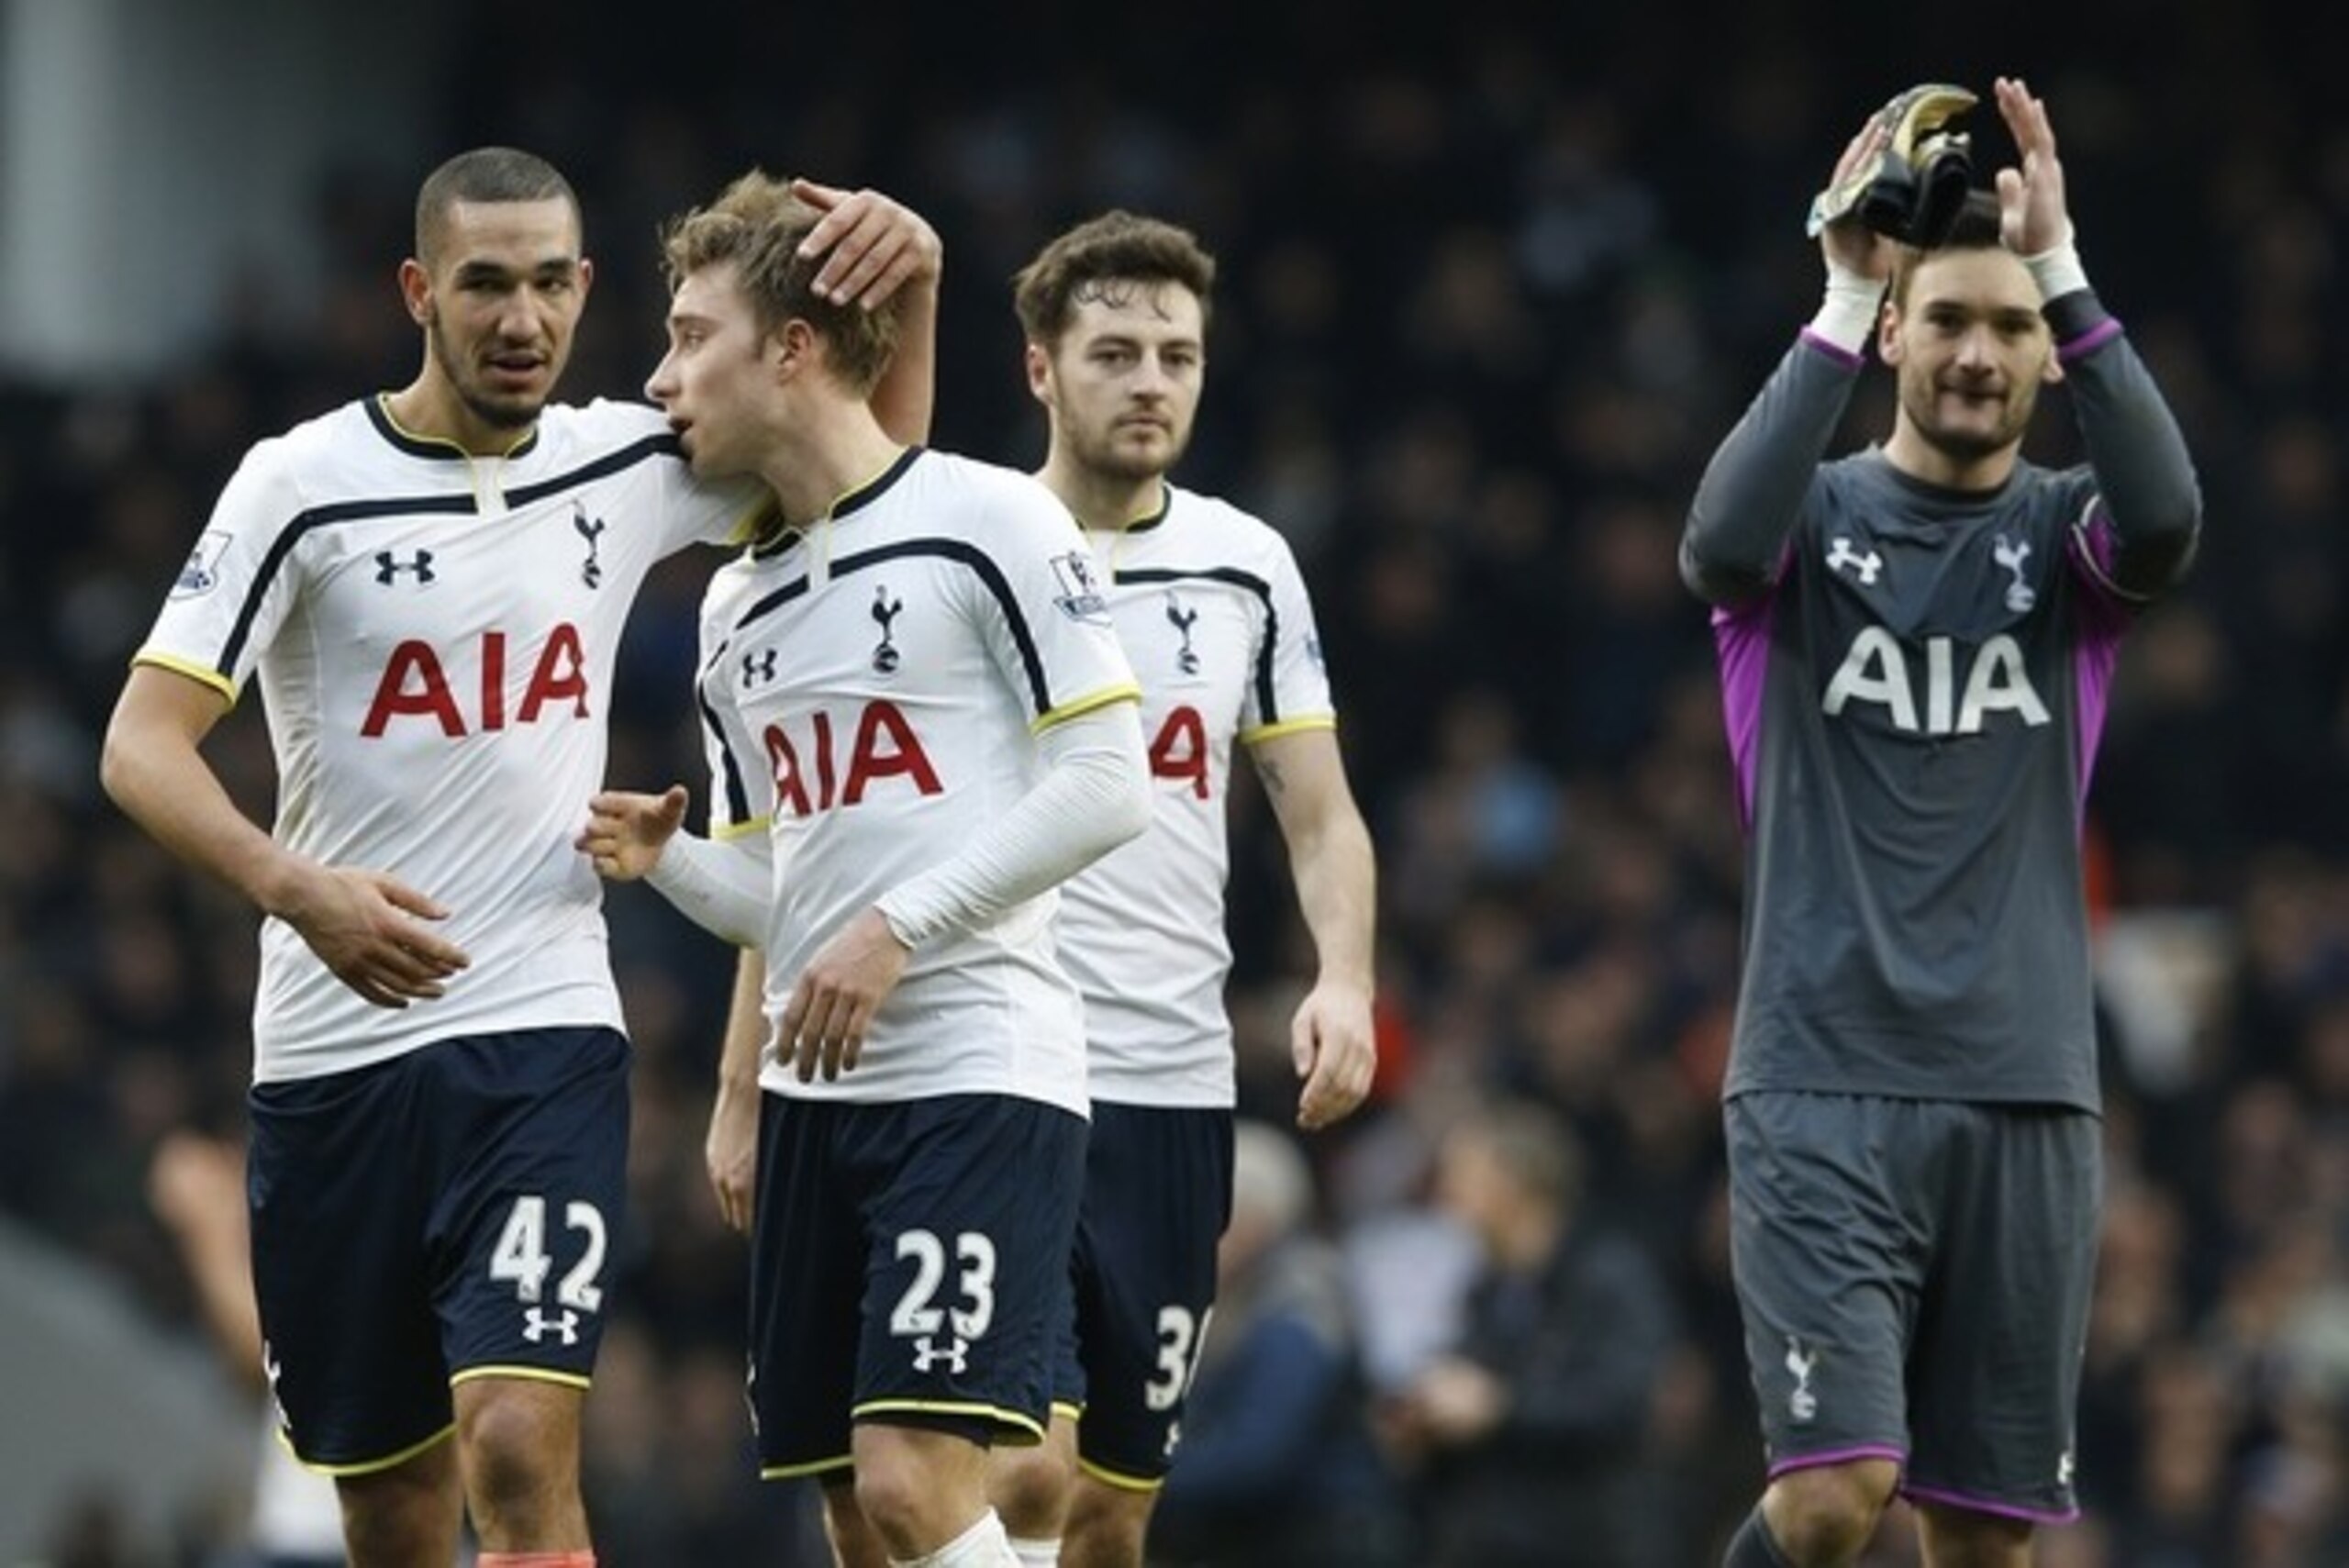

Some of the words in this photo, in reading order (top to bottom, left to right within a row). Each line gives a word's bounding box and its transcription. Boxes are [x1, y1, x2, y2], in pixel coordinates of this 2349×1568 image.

[361, 623, 589, 737] AIA
[1821, 626, 2052, 734] AIA
[763, 699, 943, 817] AIA
[489, 1195, 607, 1312] 42
[890, 1229, 996, 1340] 23
[1145, 1306, 1213, 1411] 3
